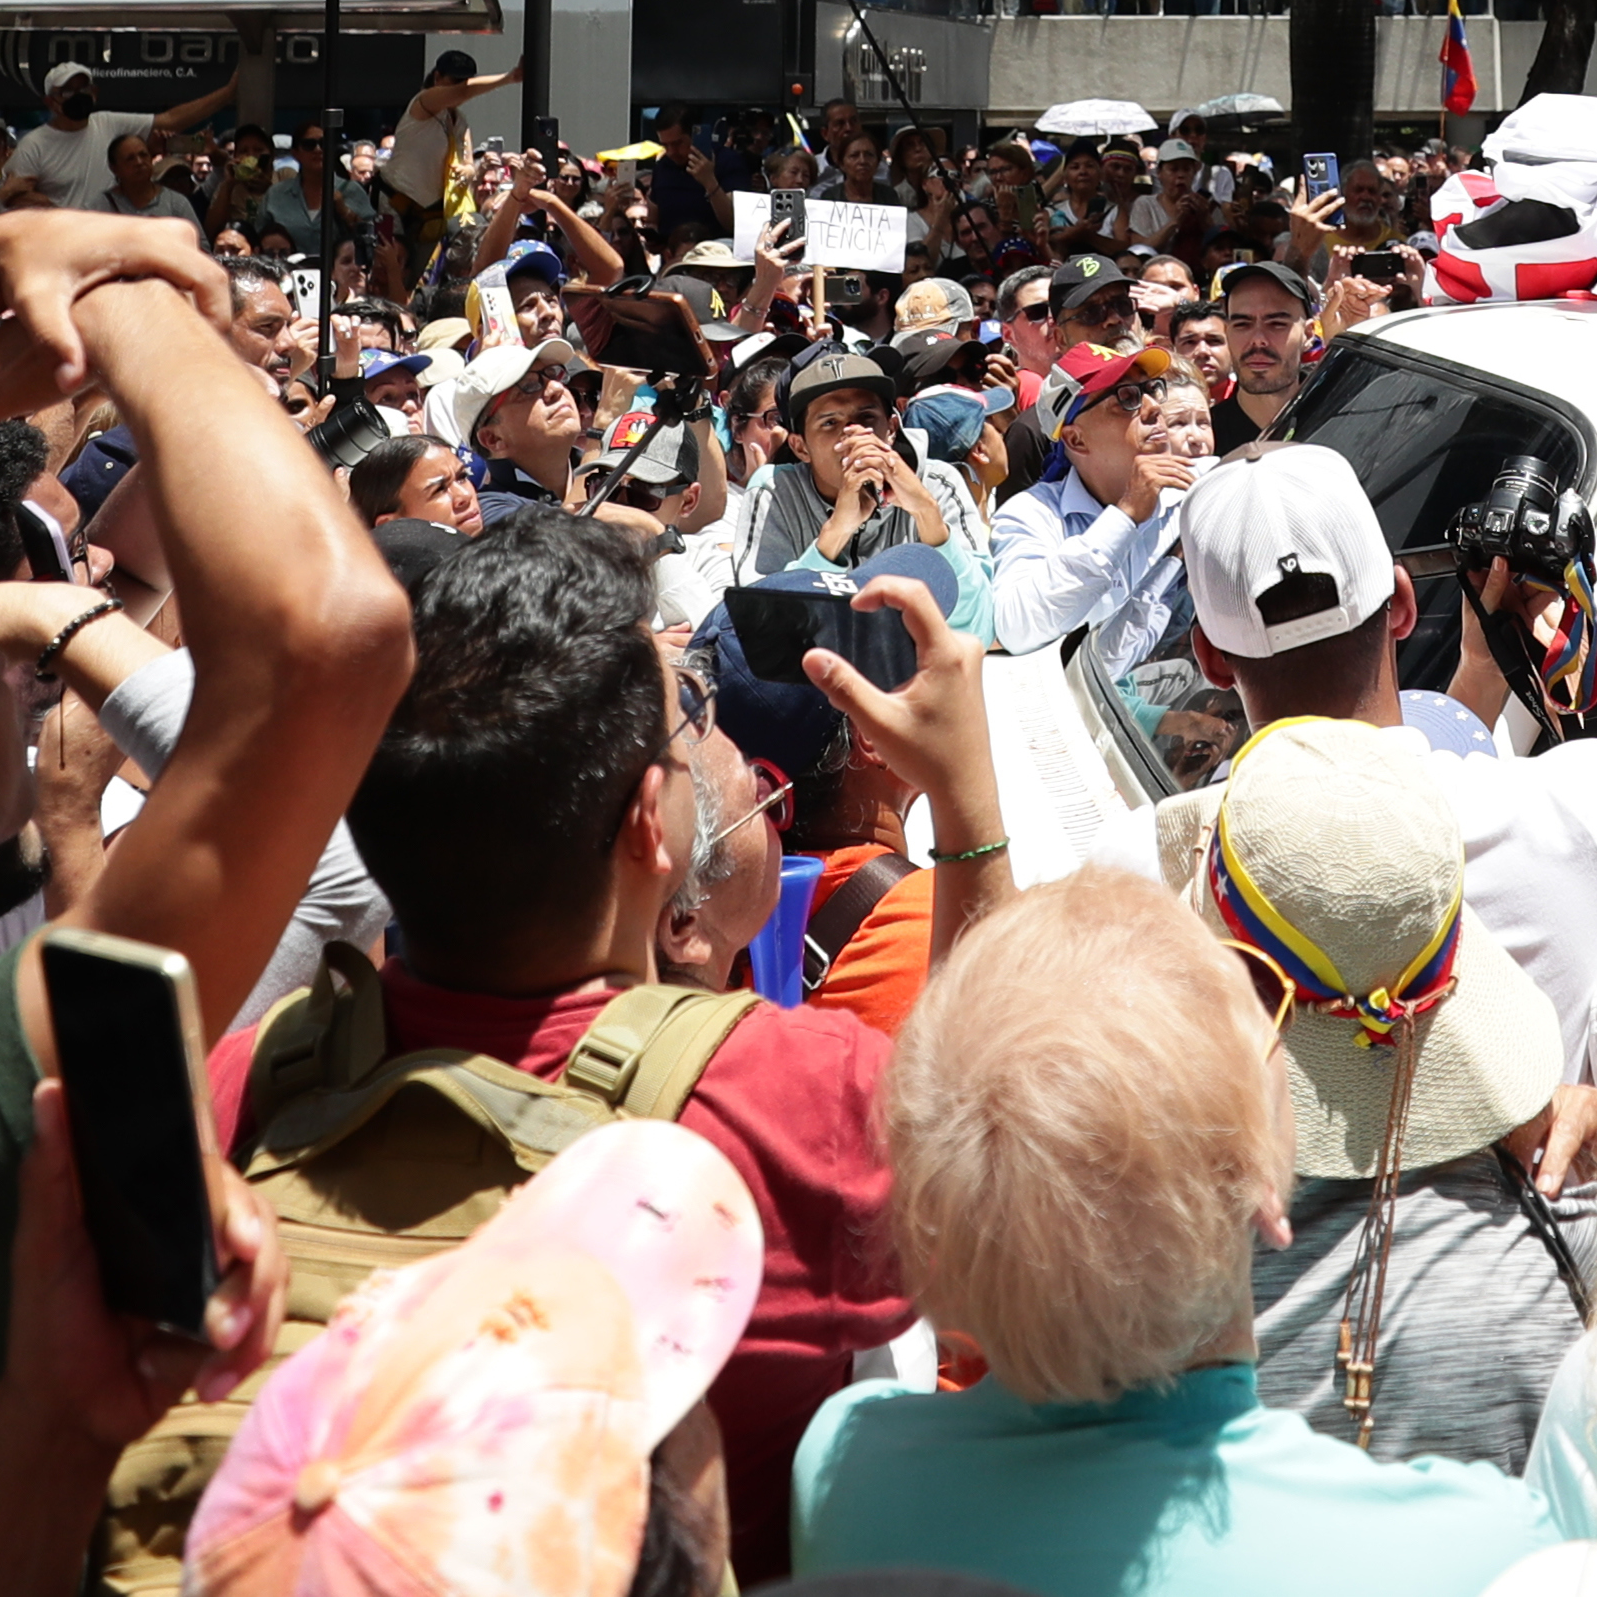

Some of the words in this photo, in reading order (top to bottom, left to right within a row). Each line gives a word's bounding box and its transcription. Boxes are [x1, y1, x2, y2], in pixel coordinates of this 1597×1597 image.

[140, 32, 319, 64] bano
[175, 66, 197, 78] C.A.
[830, 201, 891, 230] MATA
[807, 220, 887, 254] TENCIA
